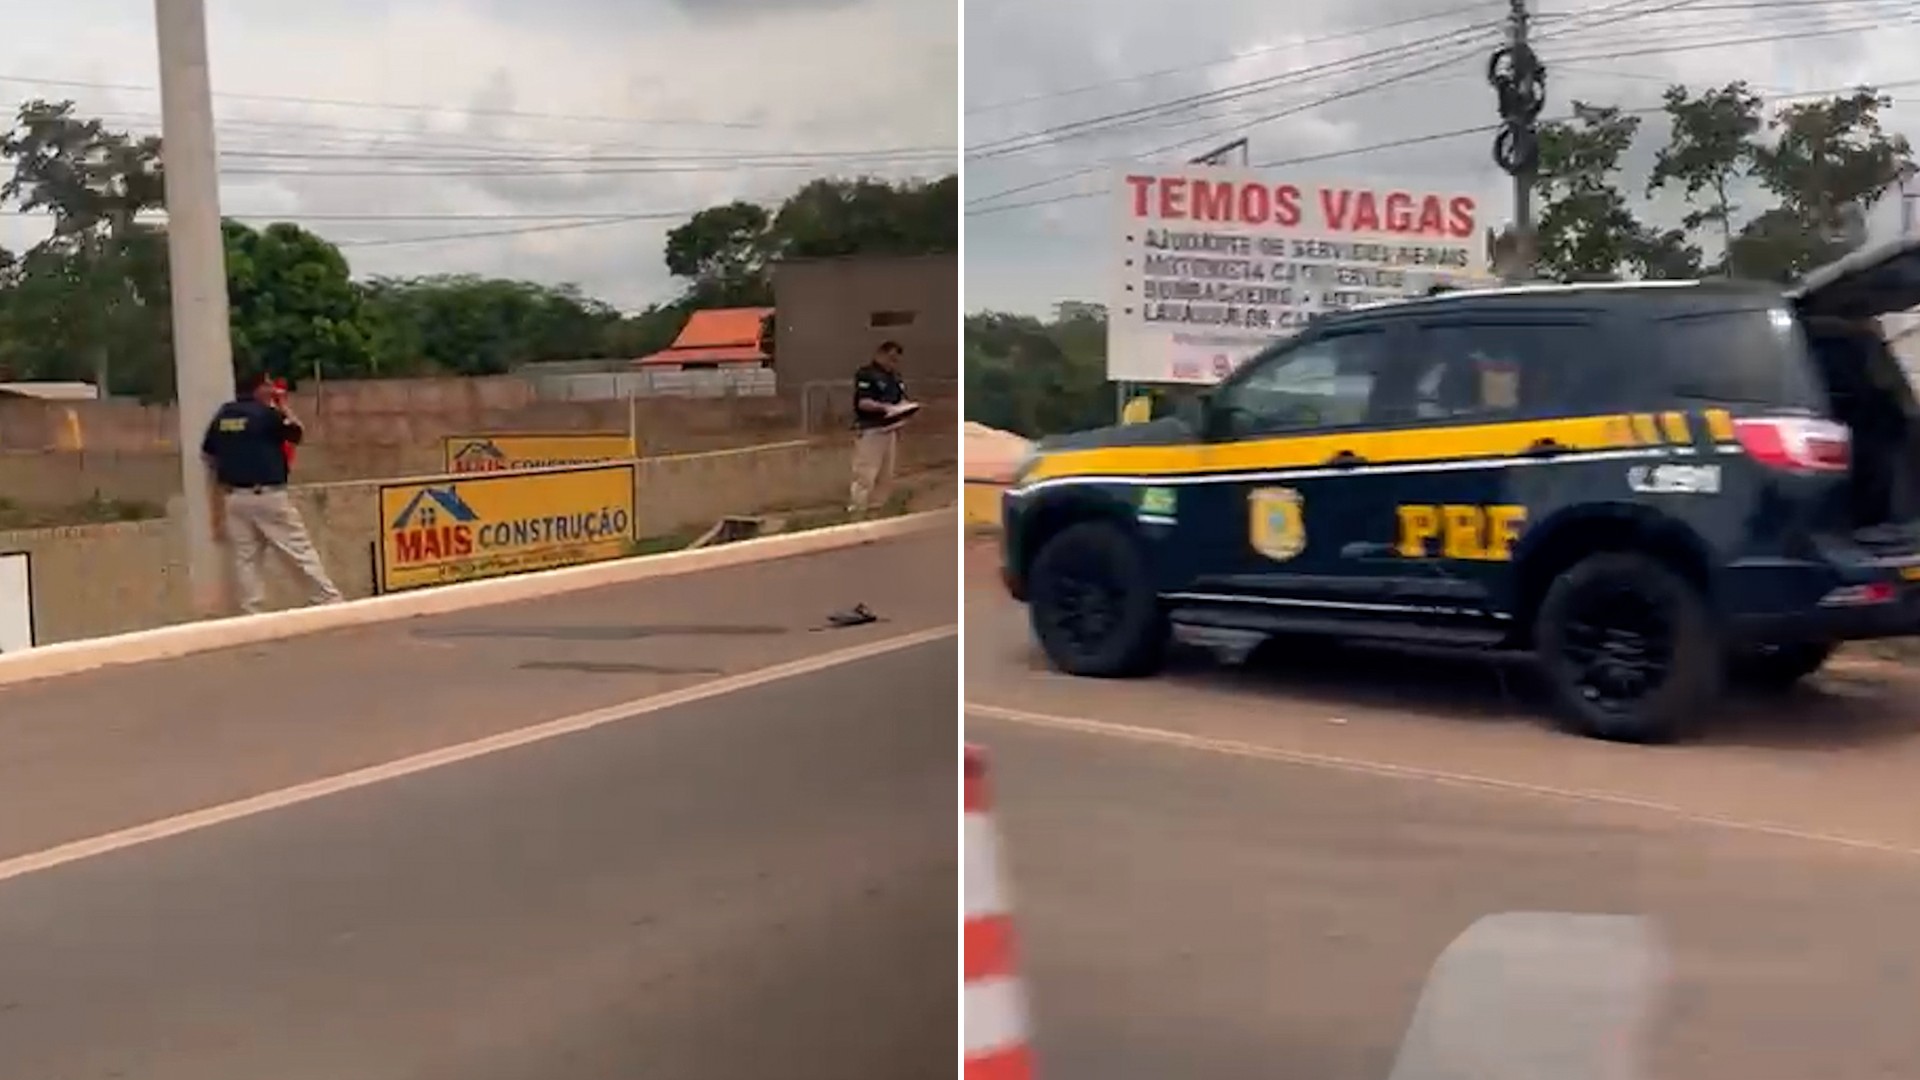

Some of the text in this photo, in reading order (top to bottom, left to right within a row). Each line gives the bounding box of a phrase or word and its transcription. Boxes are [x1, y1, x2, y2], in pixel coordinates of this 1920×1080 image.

[1126, 175, 1477, 238] TEMOS VAGAS
[393, 525, 474, 563] MAIS
[478, 506, 629, 550] CONSTRUÇÃO
[1396, 504, 1528, 560] PRF
